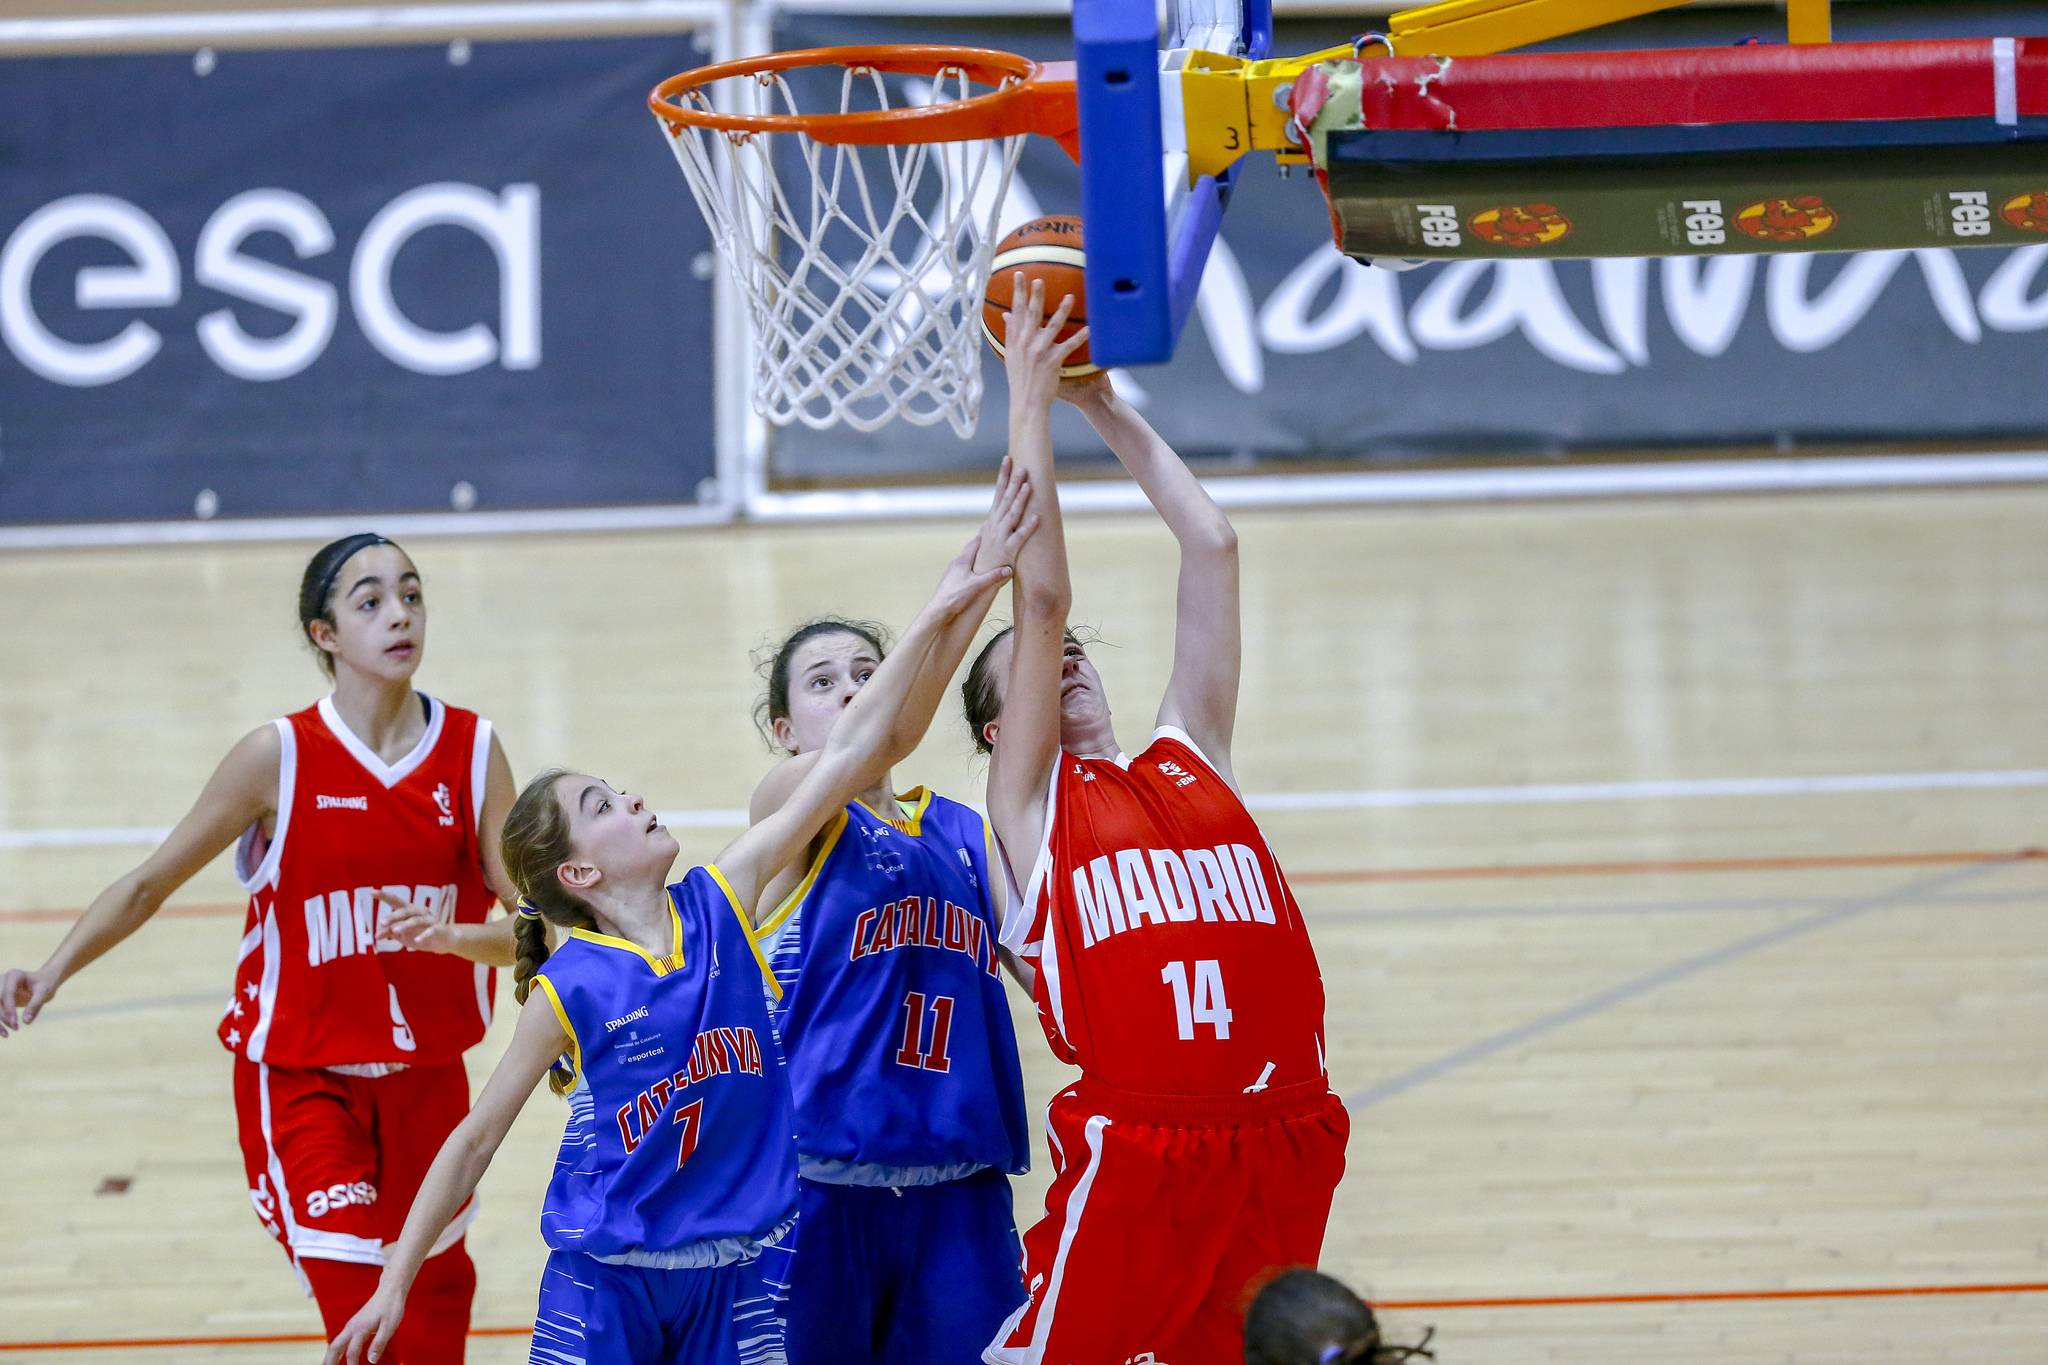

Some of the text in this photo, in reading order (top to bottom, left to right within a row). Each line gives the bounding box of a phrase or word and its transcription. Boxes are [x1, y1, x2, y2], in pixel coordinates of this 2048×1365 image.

[1225, 126, 1239, 150] 3
[0, 182, 541, 387] esa
[316, 794, 368, 811] SPALDING
[1072, 843, 1277, 950] MADRID
[850, 895, 1003, 983] CATALUNY
[605, 1005, 649, 1033] SPALDING
[896, 991, 955, 1073] 11
[1161, 959, 1233, 1041] 14
[616, 1026, 763, 1155] CATLUNYA
[627, 1046, 665, 1063] esportcat
[673, 1097, 704, 1173] 7
